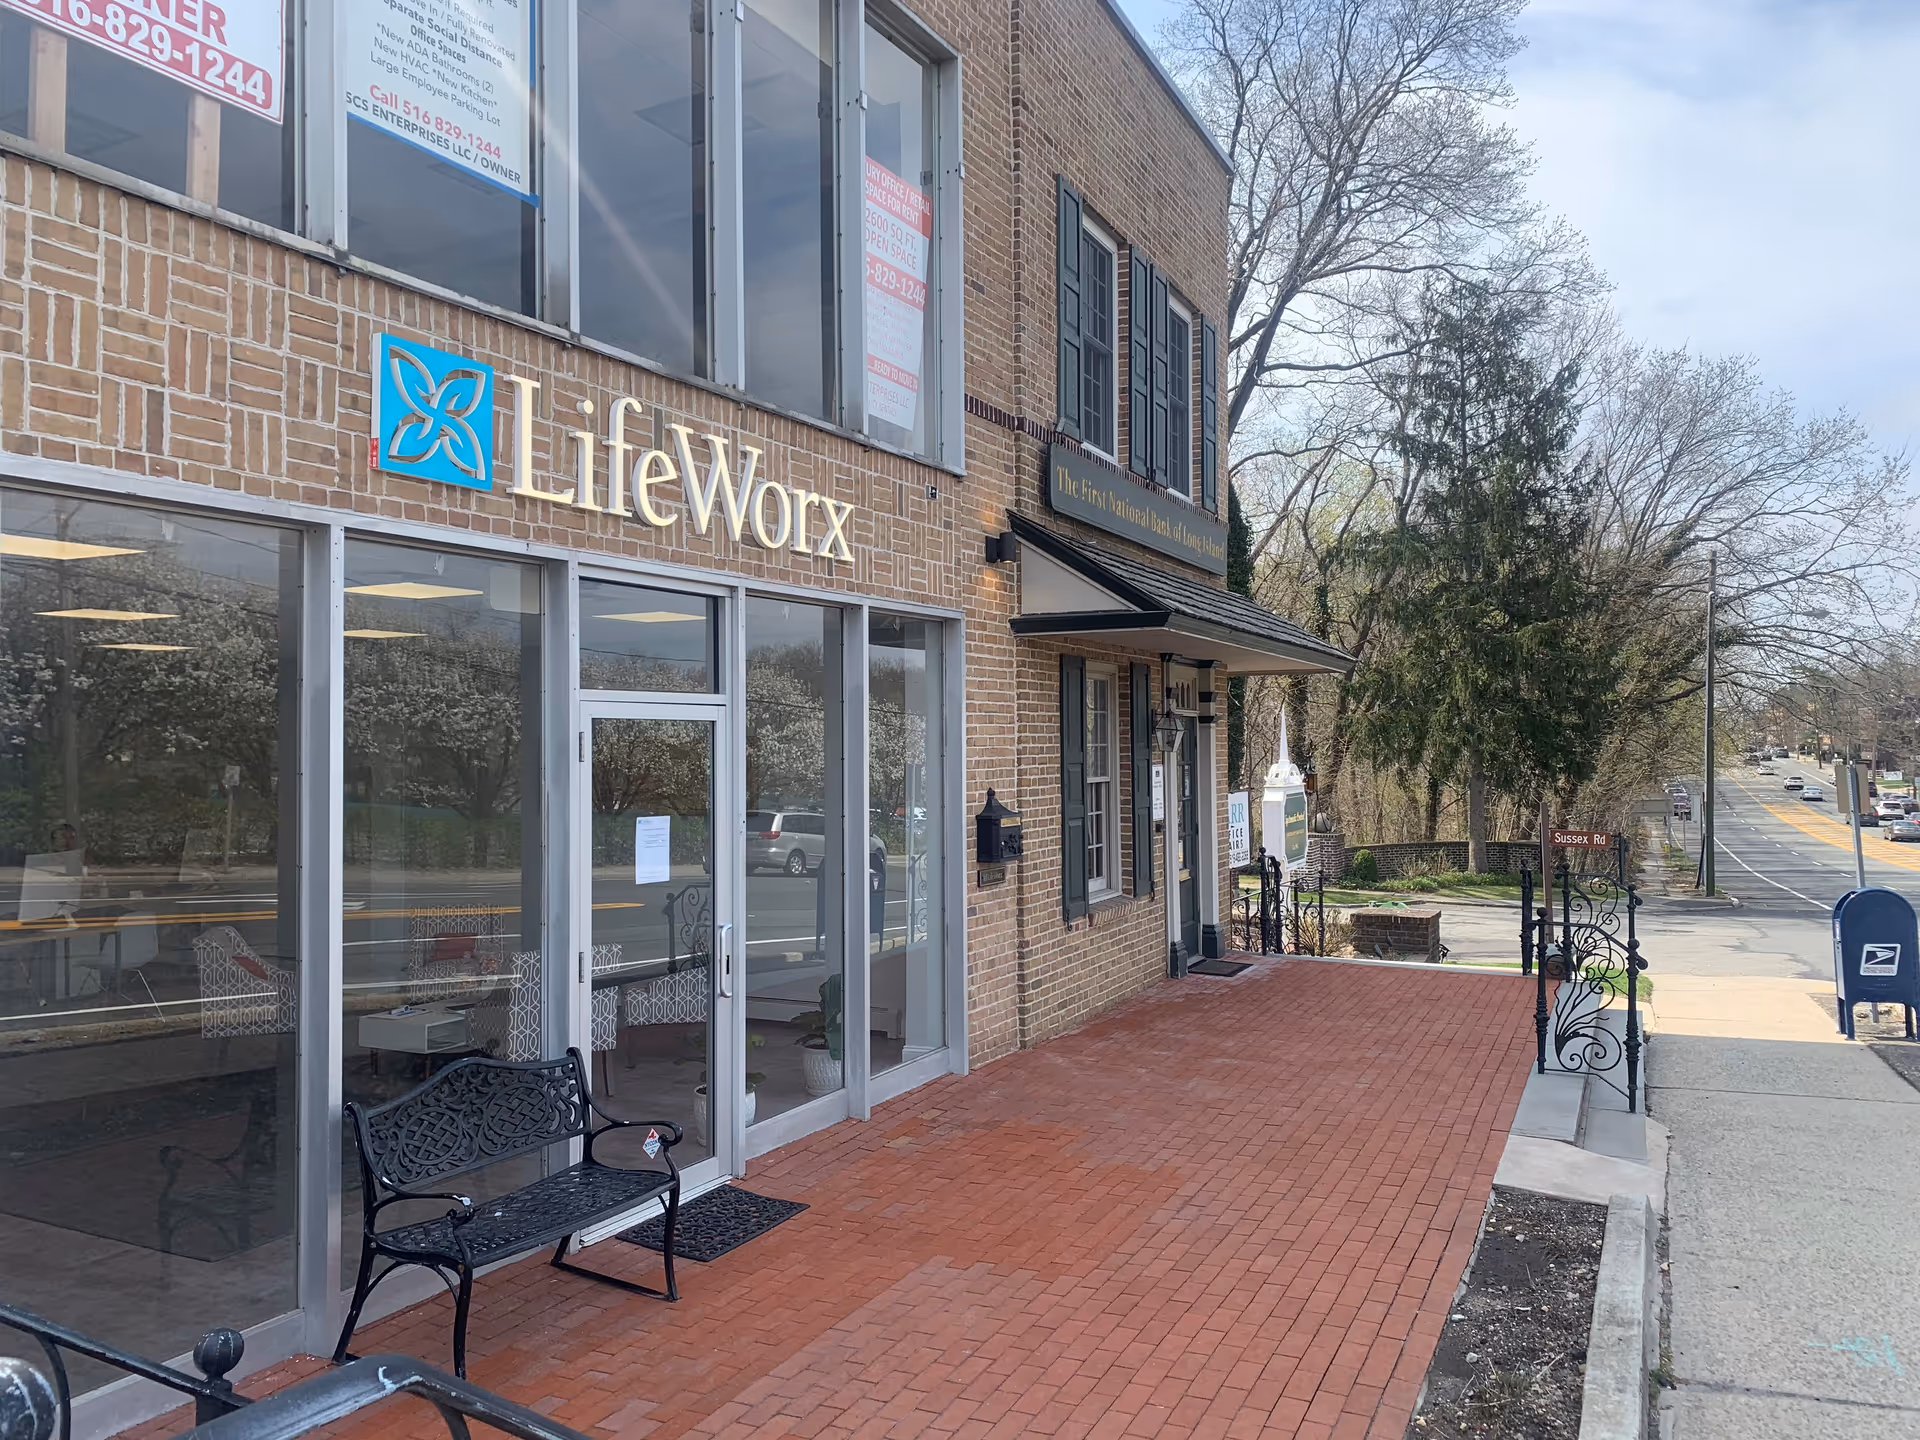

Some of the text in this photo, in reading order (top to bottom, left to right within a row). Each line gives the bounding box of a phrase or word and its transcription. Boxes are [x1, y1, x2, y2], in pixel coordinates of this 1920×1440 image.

[131, 0, 228, 46] NER
[429, 4, 438, 16] In
[447, 14, 468, 35] Fully
[470, 27, 516, 61] Renovated
[453, 3, 494, 34] Required
[25, 0, 266, 104] 6-829-1244
[374, 37, 398, 57] New
[400, 50, 429, 74] HVAC
[410, 24, 467, 64] Office Spaces
[427, 18, 458, 43] Social
[461, 36, 503, 68] Distance
[370, 51, 501, 127] Large Employee Parking Lot
[407, 40, 429, 59] ADA
[432, 52, 480, 87] Bathrooms
[482, 80, 494, 94] (2)
[345, 91, 369, 112] SCS
[372, 103, 450, 150] ENTERPRISES
[453, 142, 471, 160] LLC
[480, 156, 521, 184] OWNER
[369, 84, 501, 159] Call 516 829-1244
[866, 180, 919, 225] SPACE FOR RENT
[881, 173, 904, 199] OFFICE
[910, 191, 930, 216] RETAIL
[866, 207, 888, 233] 2600
[891, 223, 903, 245] SQ
[866, 227, 917, 270] OPEN SPACE
[503, 374, 856, 562] LifeWorx
[1056, 464, 1225, 561] The First National Bank of Long Island
[1229, 802, 1245, 824] RR
[1554, 832, 1606, 845] Sussex Rd
